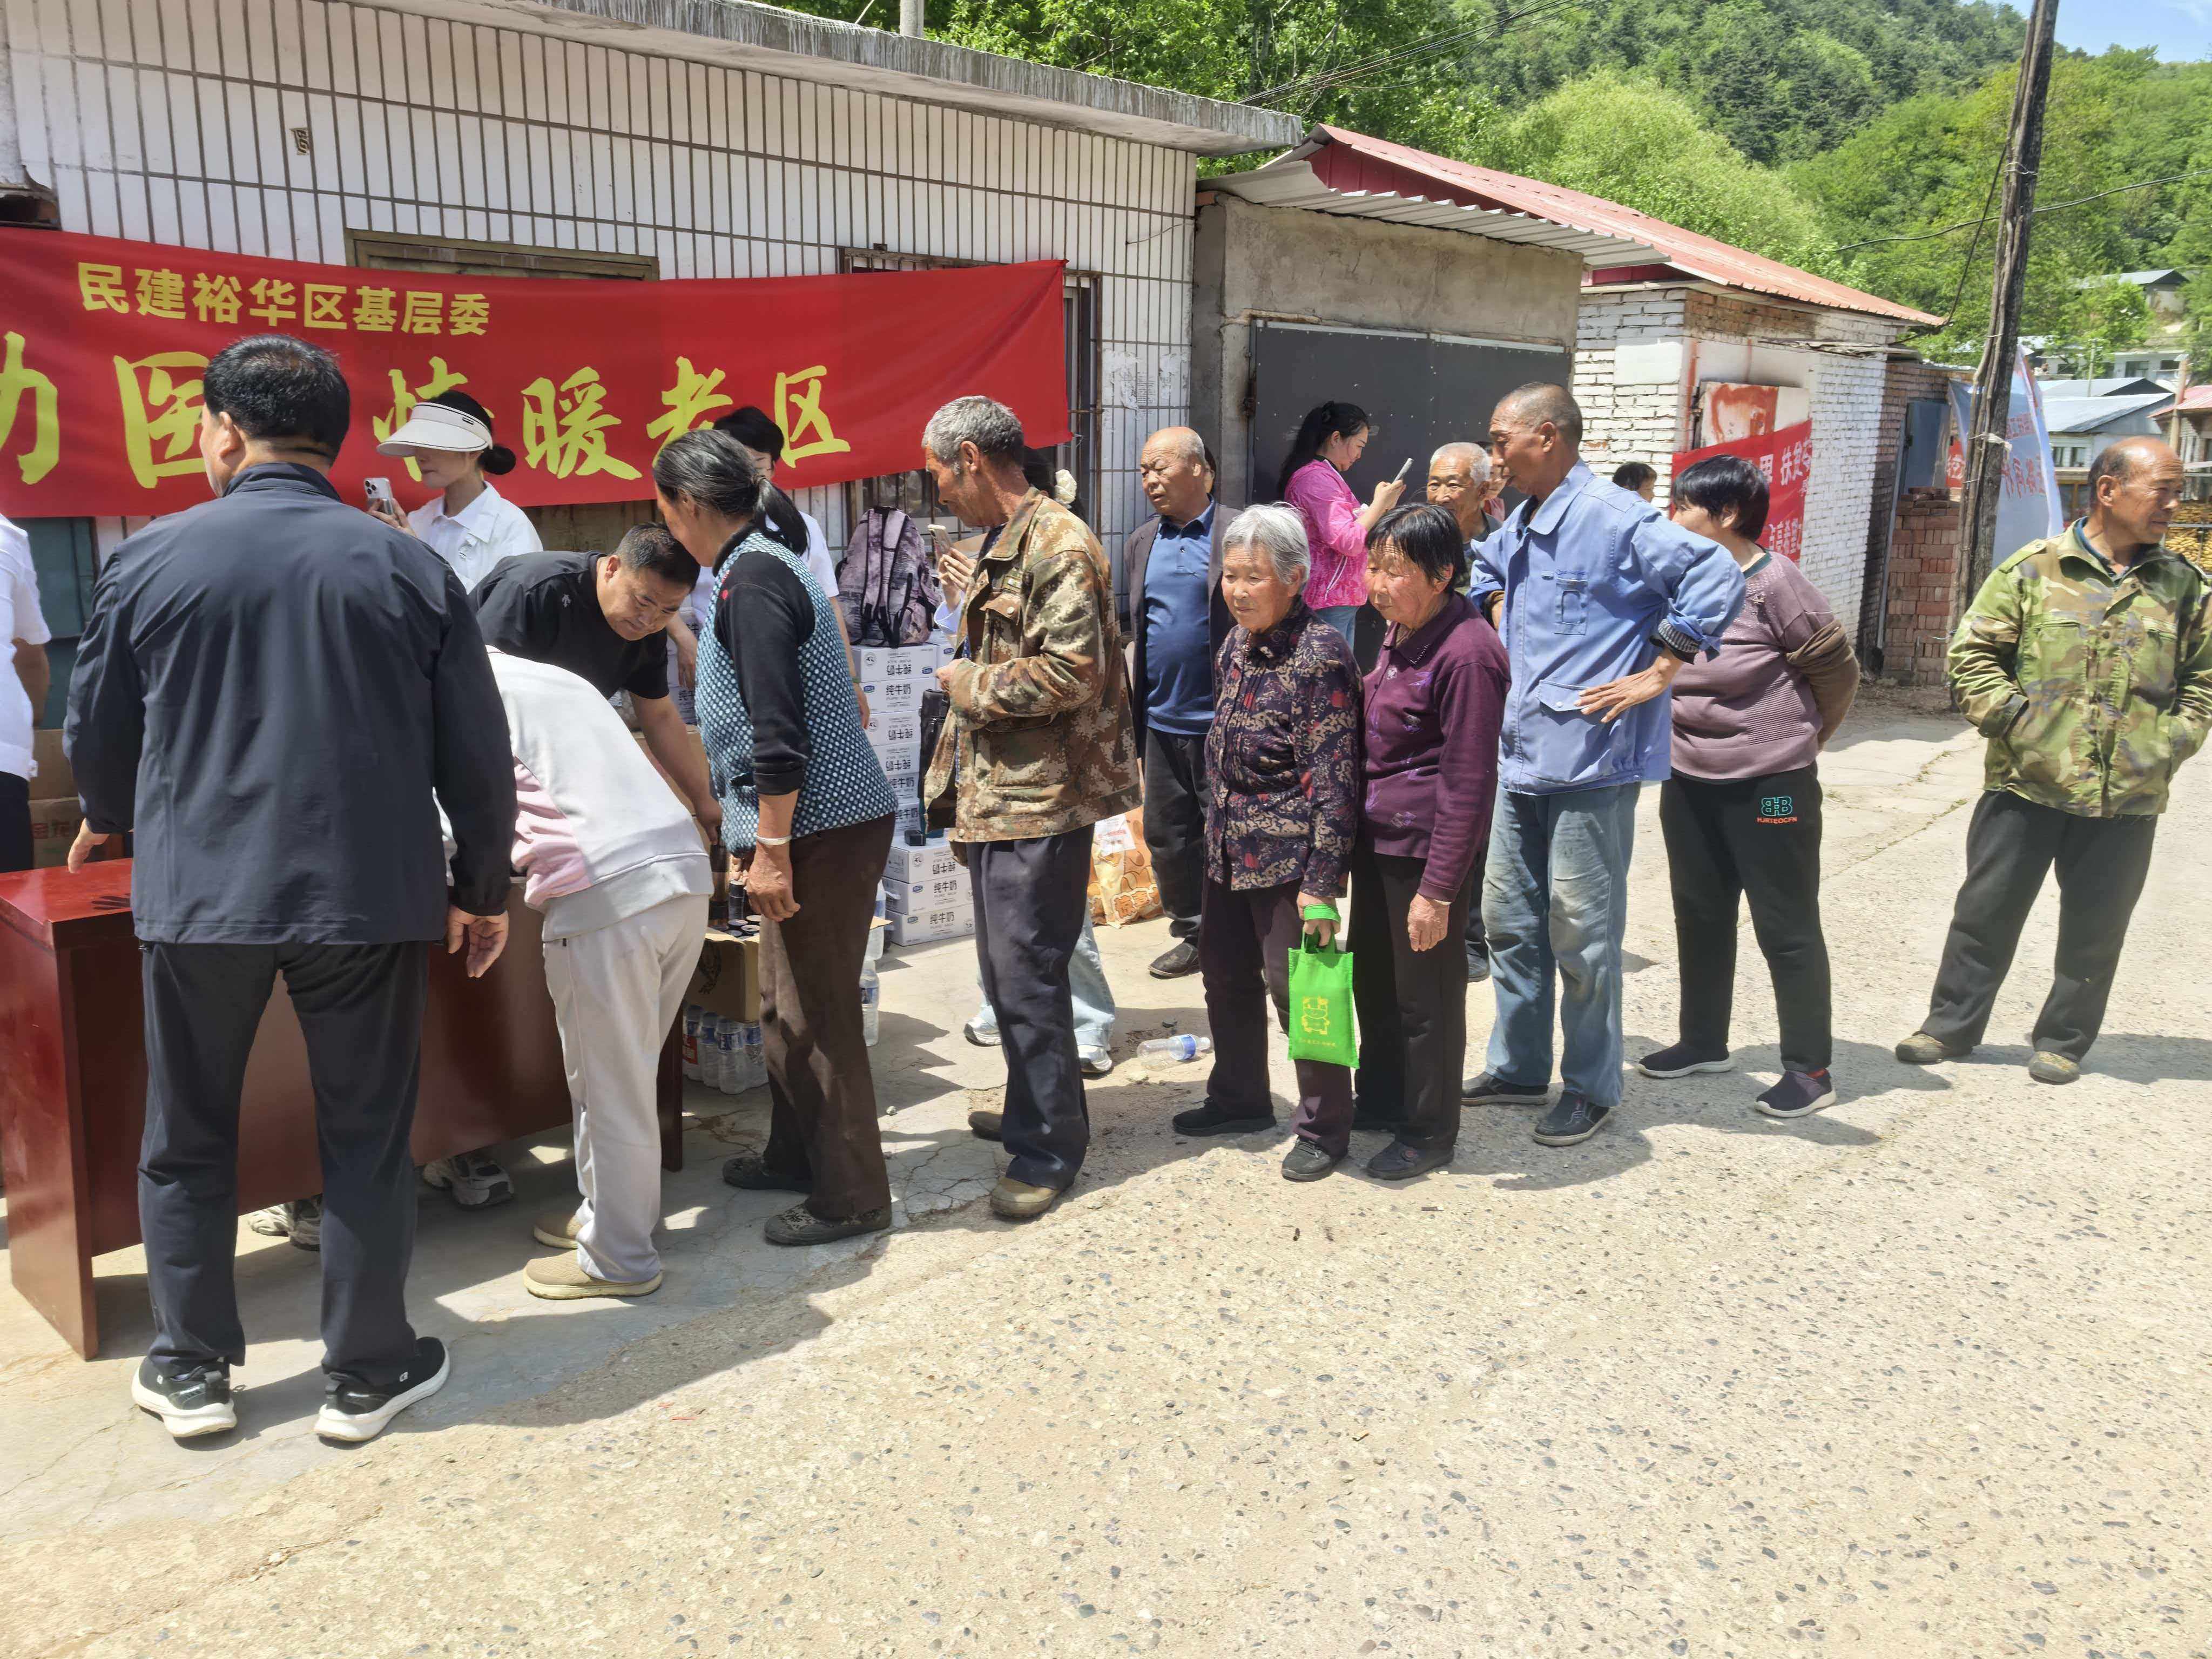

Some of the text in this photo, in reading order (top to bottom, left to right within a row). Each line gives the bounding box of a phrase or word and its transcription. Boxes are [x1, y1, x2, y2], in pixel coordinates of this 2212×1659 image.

[77, 261, 490, 336] 民建裕华区基层委
